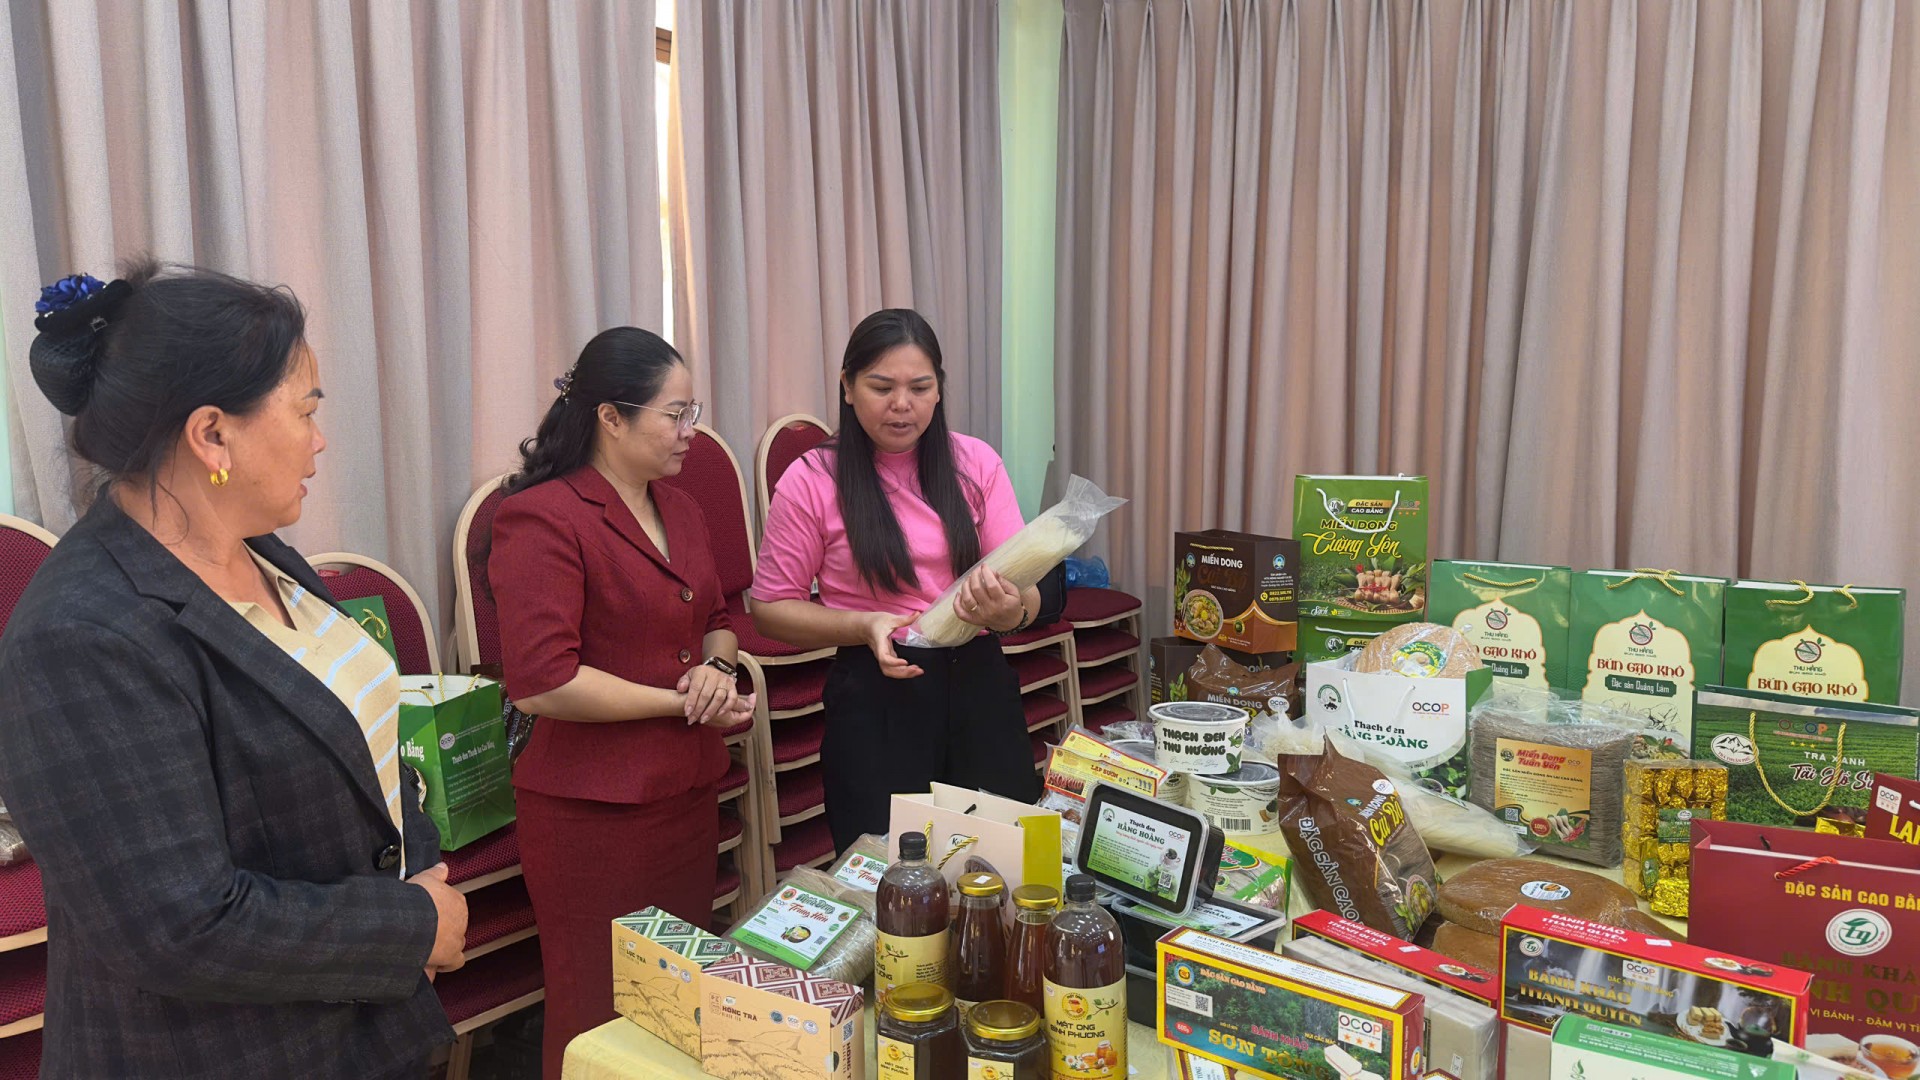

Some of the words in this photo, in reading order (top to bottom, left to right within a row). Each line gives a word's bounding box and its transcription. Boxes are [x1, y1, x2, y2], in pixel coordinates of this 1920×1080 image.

[1220, 558, 1243, 569] DONG
[1233, 698, 1263, 709] DONG
[1412, 702, 1450, 713] OCOP
[1778, 719, 1829, 735] OCOP
[1162, 727, 1199, 742] THẠCH
[1202, 731, 1226, 743] ĐEN
[1163, 741, 1181, 754] THU
[1880, 790, 1899, 801] OCOP
[1168, 830, 1185, 840] OCOP
[1785, 880, 1816, 898] ĐẶC
[1821, 884, 1852, 902] SẢN
[1857, 891, 1889, 907] CAO
[1333, 884, 1360, 922] CAO
[1627, 963, 1656, 975] OCOP
[1810, 1007, 1820, 1018] VỊ
[1823, 1010, 1855, 1023] BÁNH
[1340, 1015, 1381, 1036] OCOP
[1251, 1024, 1279, 1042] BÁNH
